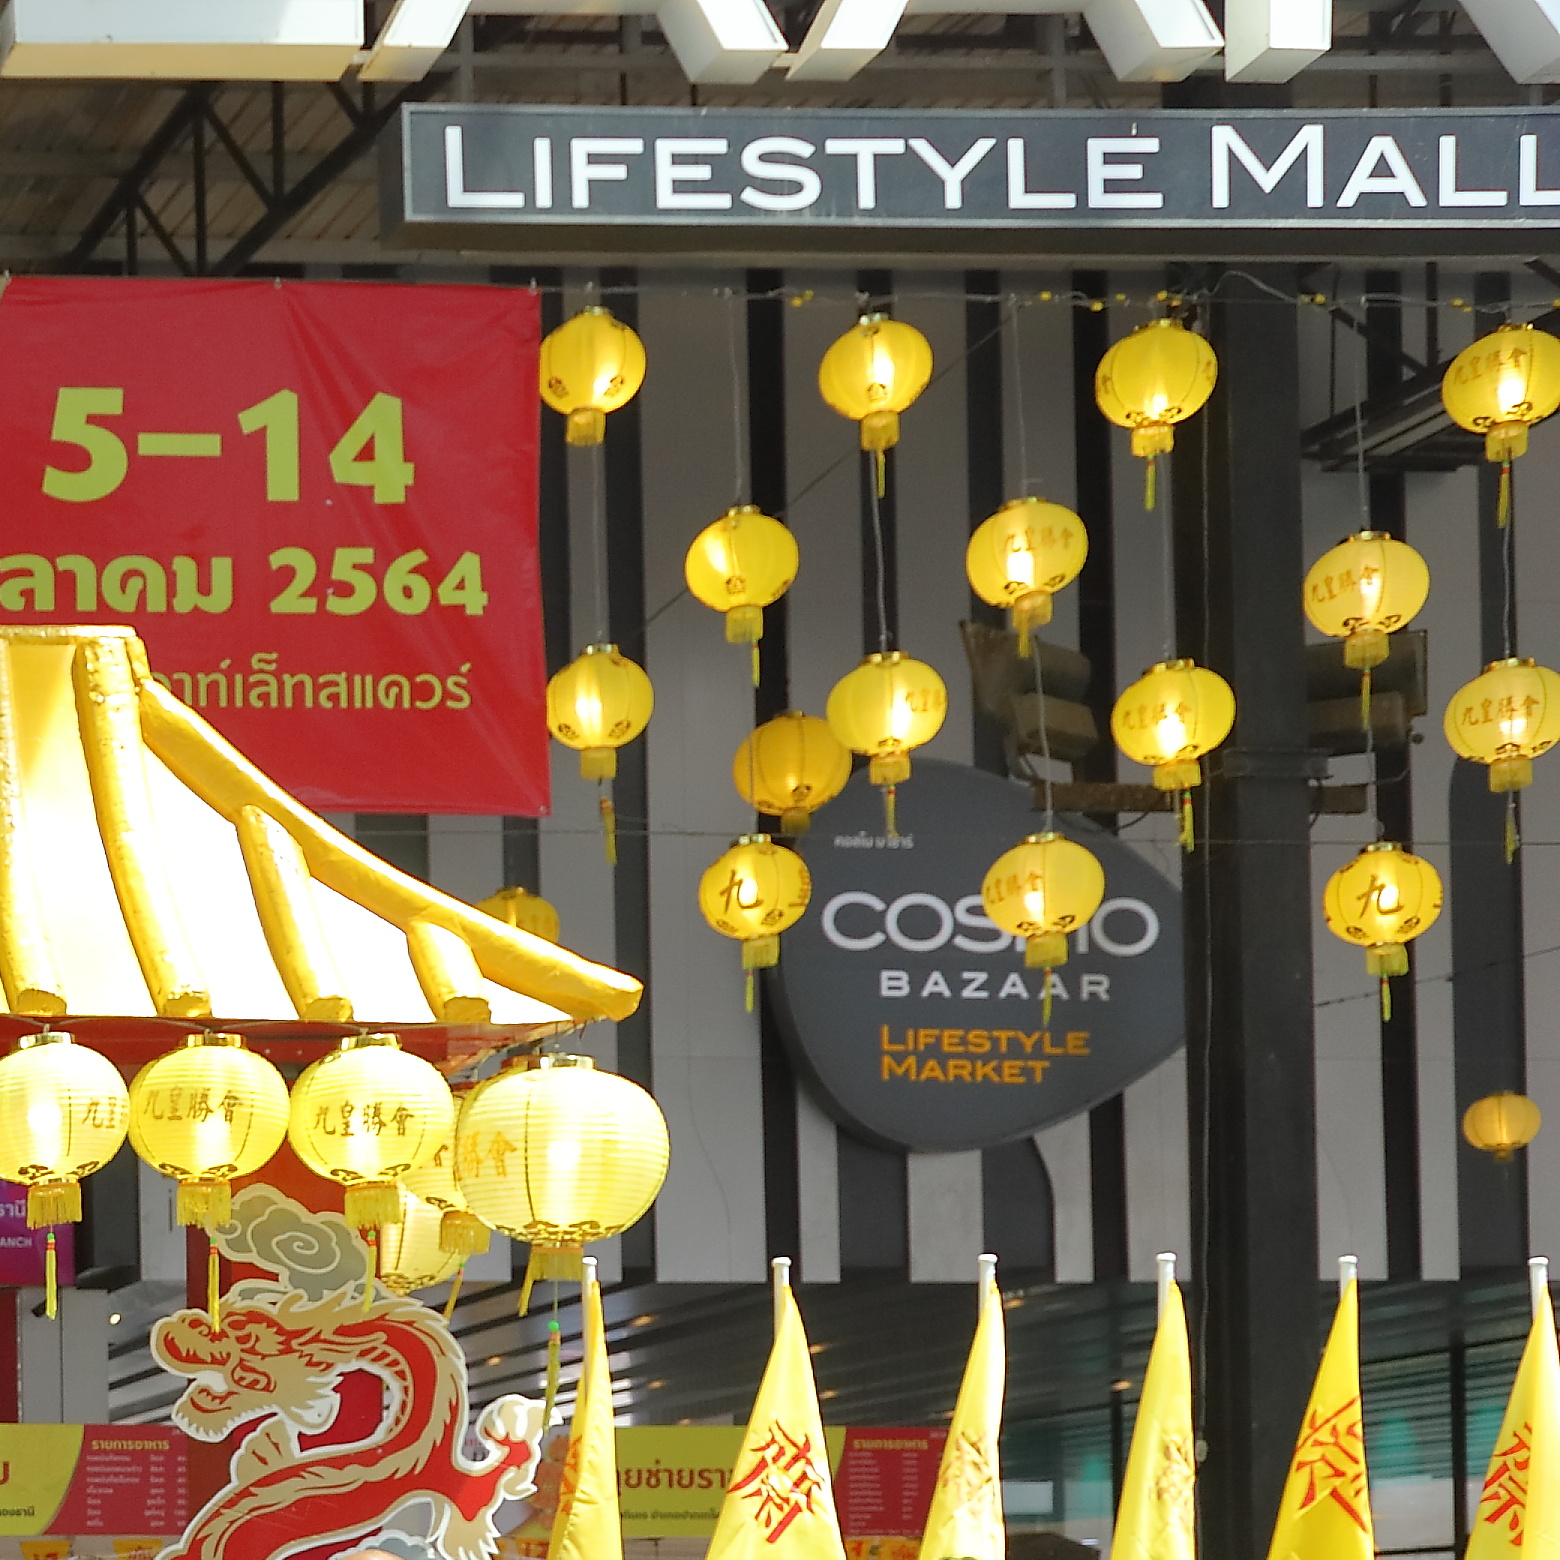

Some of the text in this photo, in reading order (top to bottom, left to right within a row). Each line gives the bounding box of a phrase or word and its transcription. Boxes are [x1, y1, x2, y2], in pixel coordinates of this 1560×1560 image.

[444, 124, 1560, 211] LIFESTYLE MALL
[268, 547, 489, 616] 2564
[720, 869, 765, 914] 九
[1356, 874, 1404, 918] 九
[880, 969, 1111, 1001] BAZAAR
[880, 1024, 1091, 1056] LIFESTYLE
[881, 1054, 1051, 1085] MARKET
[143, 1088, 243, 1126] 九皇勝會
[313, 1100, 415, 1138] 九皇勝會
